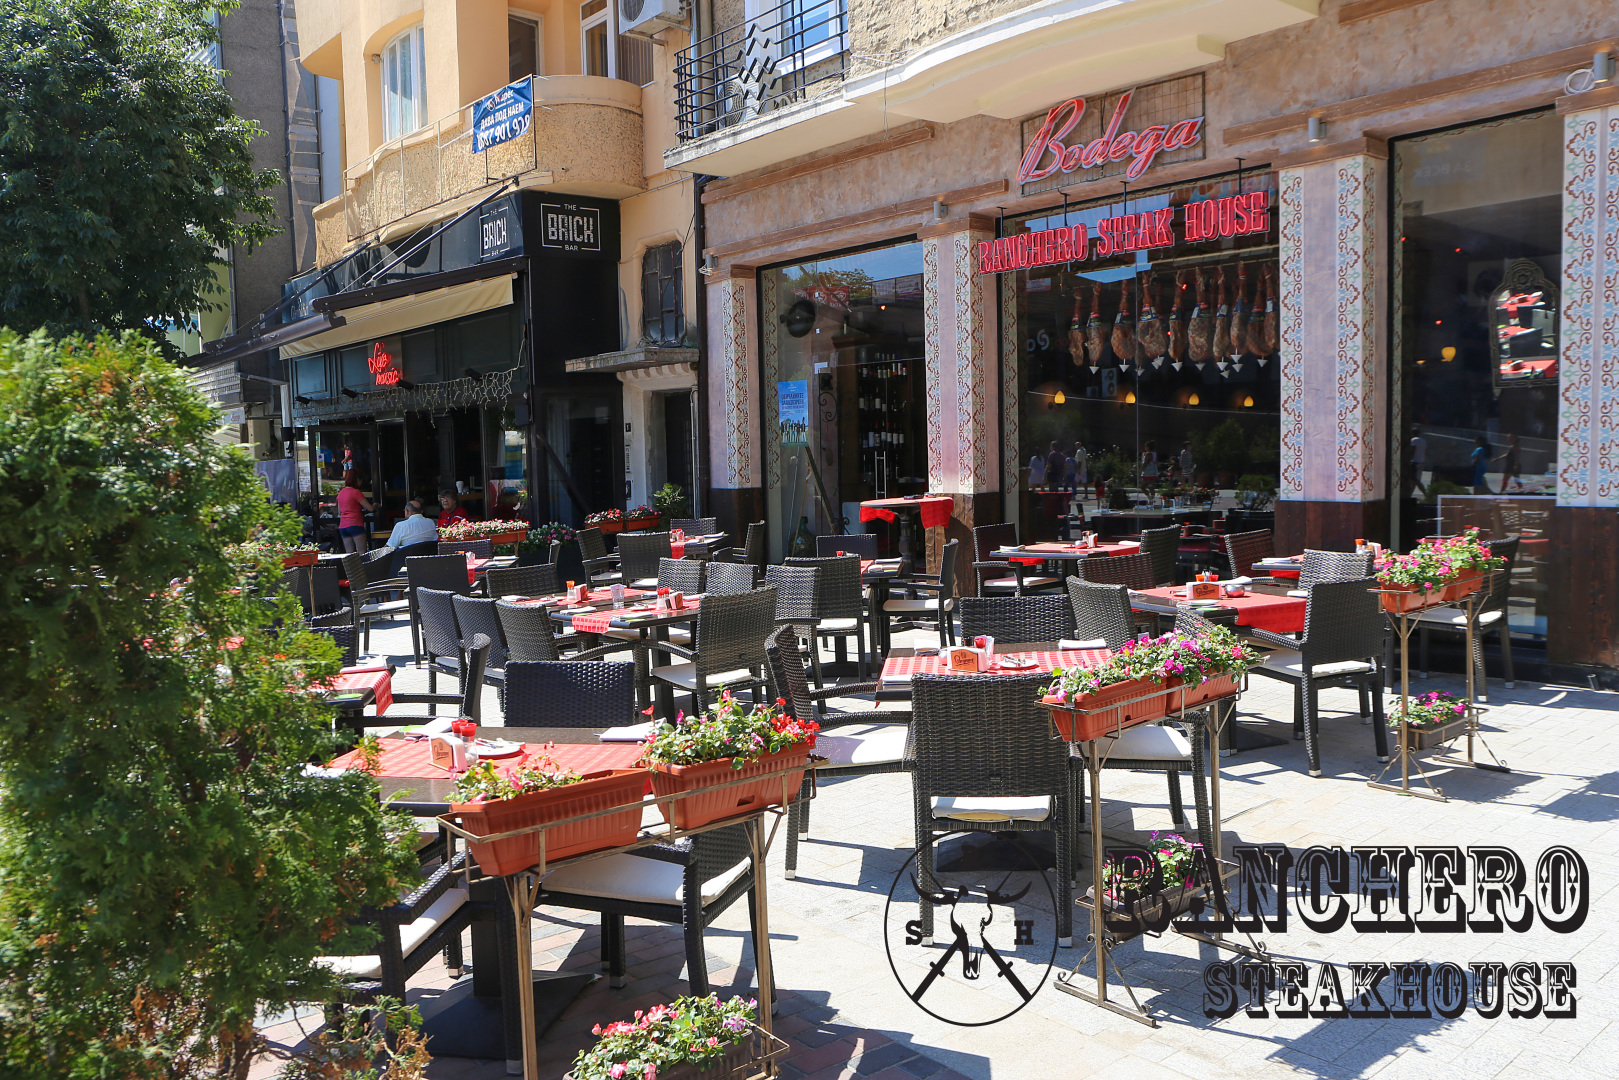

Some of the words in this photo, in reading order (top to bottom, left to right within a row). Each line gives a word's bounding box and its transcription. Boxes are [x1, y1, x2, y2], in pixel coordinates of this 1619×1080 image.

[508, 102, 524, 117] НАЕМ
[495, 122, 511, 142] 901
[1016, 87, 1205, 186] Bodega
[483, 217, 507, 250] BRICK
[547, 213, 594, 243] BRICK
[978, 223, 1089, 275] RANCHERO
[1096, 207, 1175, 257] STEAK
[1183, 190, 1270, 243] HOUSE
